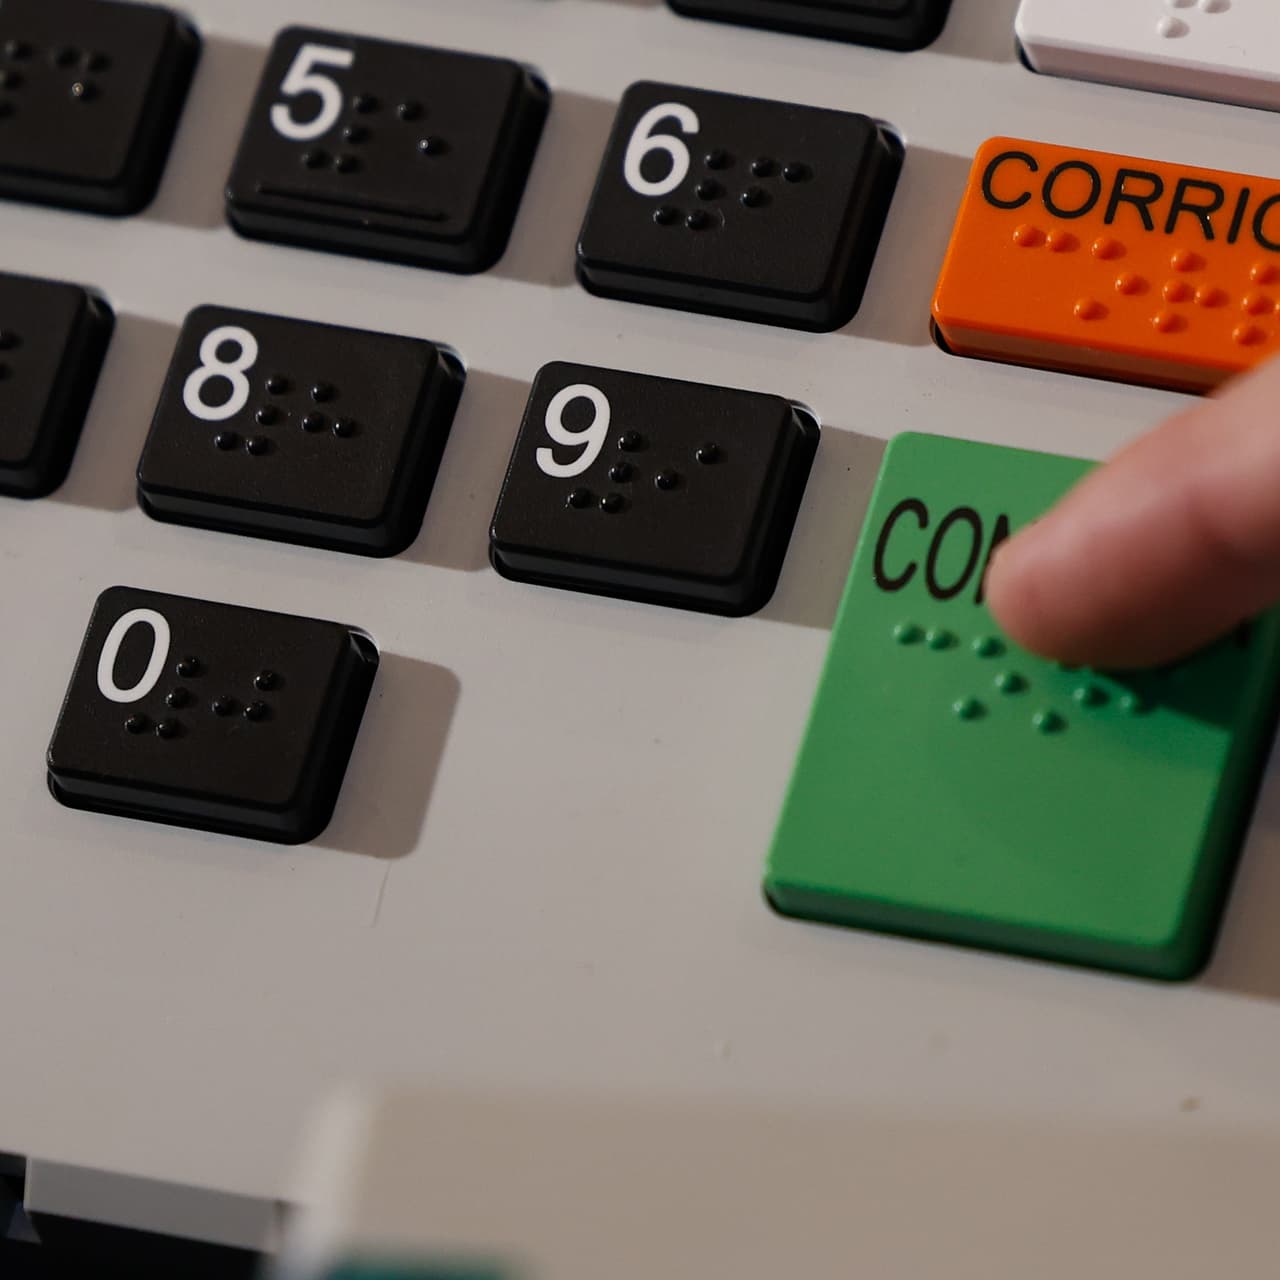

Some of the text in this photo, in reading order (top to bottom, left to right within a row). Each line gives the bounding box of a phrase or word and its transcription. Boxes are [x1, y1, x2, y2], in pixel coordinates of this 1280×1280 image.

[269, 43, 356, 141] 5
[623, 101, 700, 197] 6
[182, 324, 259, 421] 8
[535, 382, 612, 479] 9
[96, 607, 172, 704] 0
